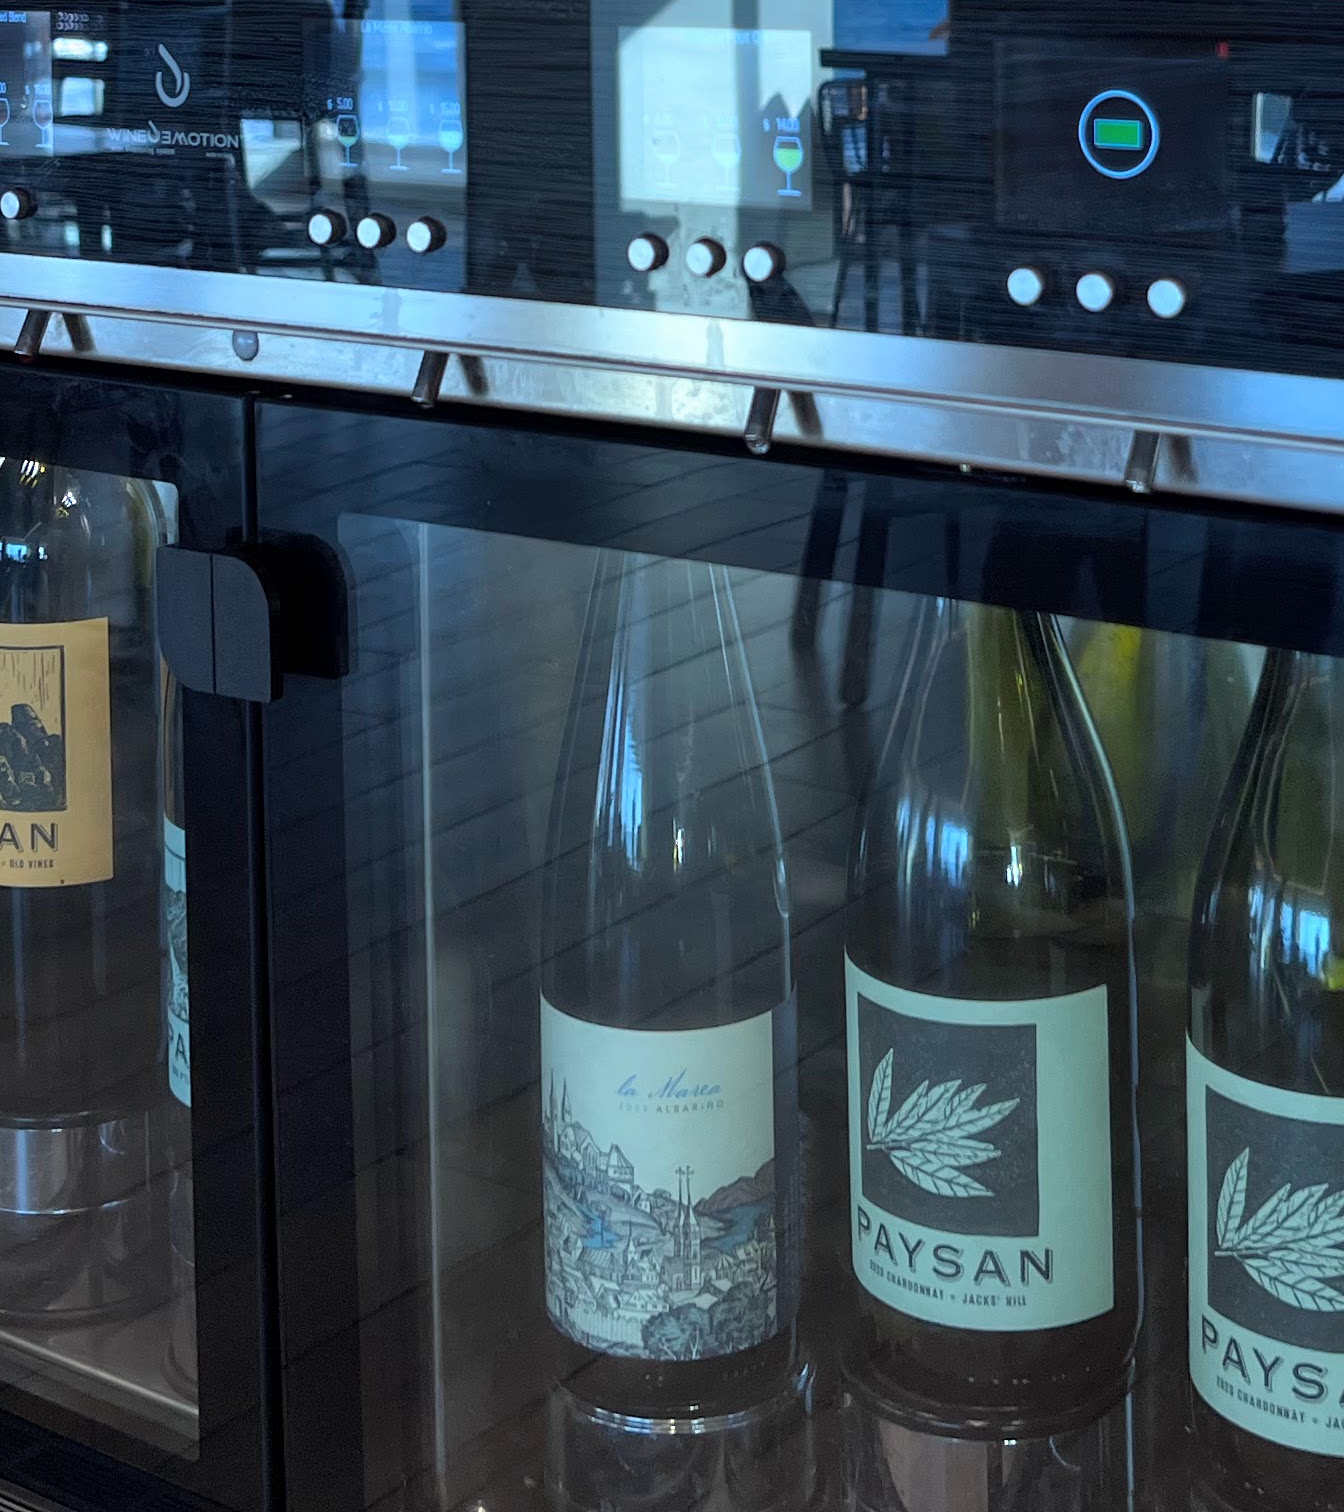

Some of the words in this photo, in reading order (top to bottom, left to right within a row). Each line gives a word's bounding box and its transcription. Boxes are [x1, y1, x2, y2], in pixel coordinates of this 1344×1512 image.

[8, 11, 27, 23] Blend
[857, 1204, 1053, 1288] PAYSAN
[886, 1270, 944, 1301] CHARDONNAY
[1237, 1388, 1305, 1423] CHARDONNAY
